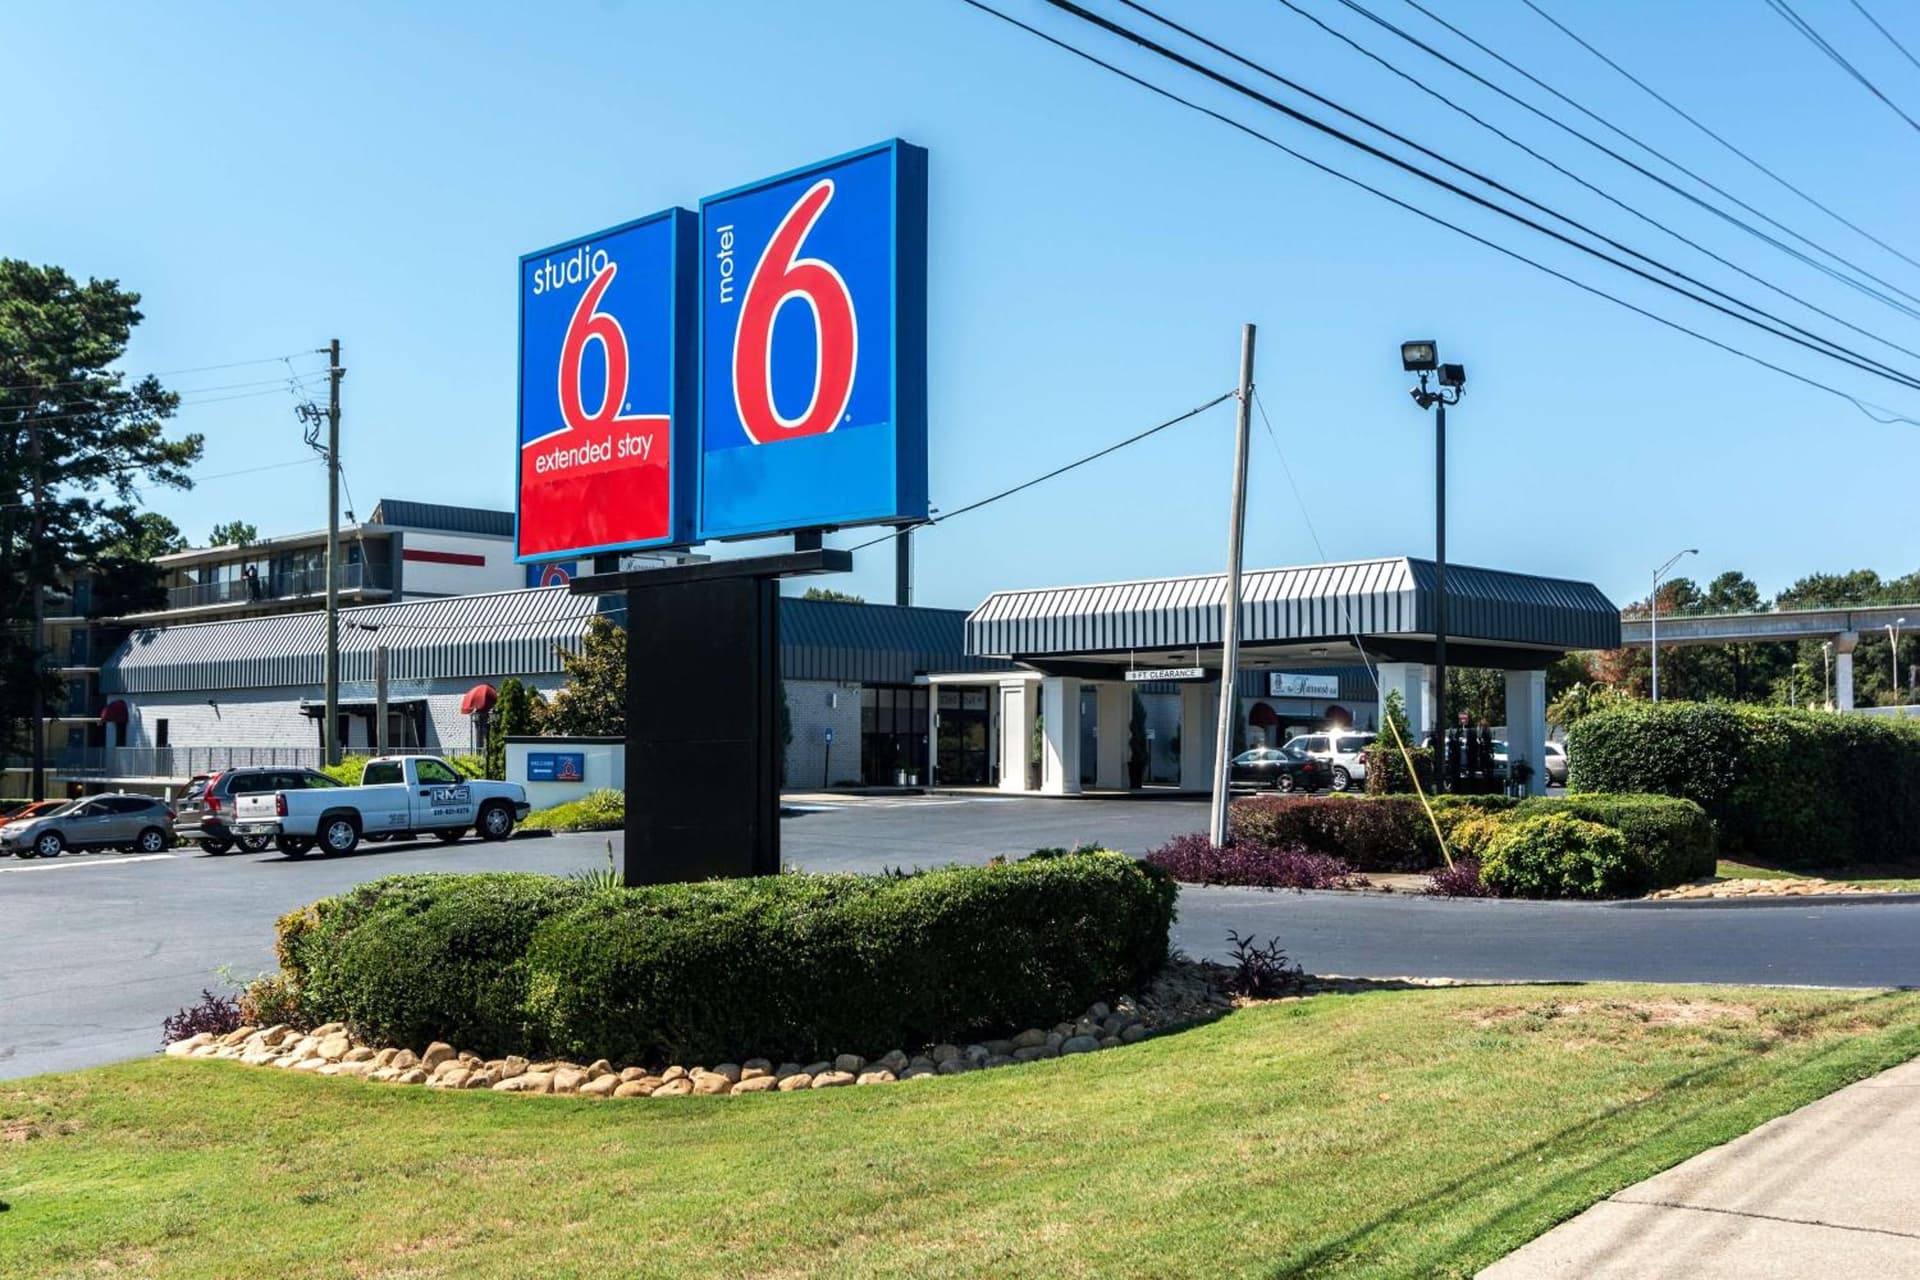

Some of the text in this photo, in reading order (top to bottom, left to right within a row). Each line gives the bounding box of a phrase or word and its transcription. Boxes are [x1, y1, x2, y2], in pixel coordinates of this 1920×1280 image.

[533, 245, 608, 295] studio
[716, 224, 734, 304] motel
[732, 178, 858, 445] 6
[558, 262, 630, 431] 6
[535, 432, 653, 473] extended stay
[1150, 668, 1196, 679] CLEARANCE
[433, 789, 468, 801] RMS
